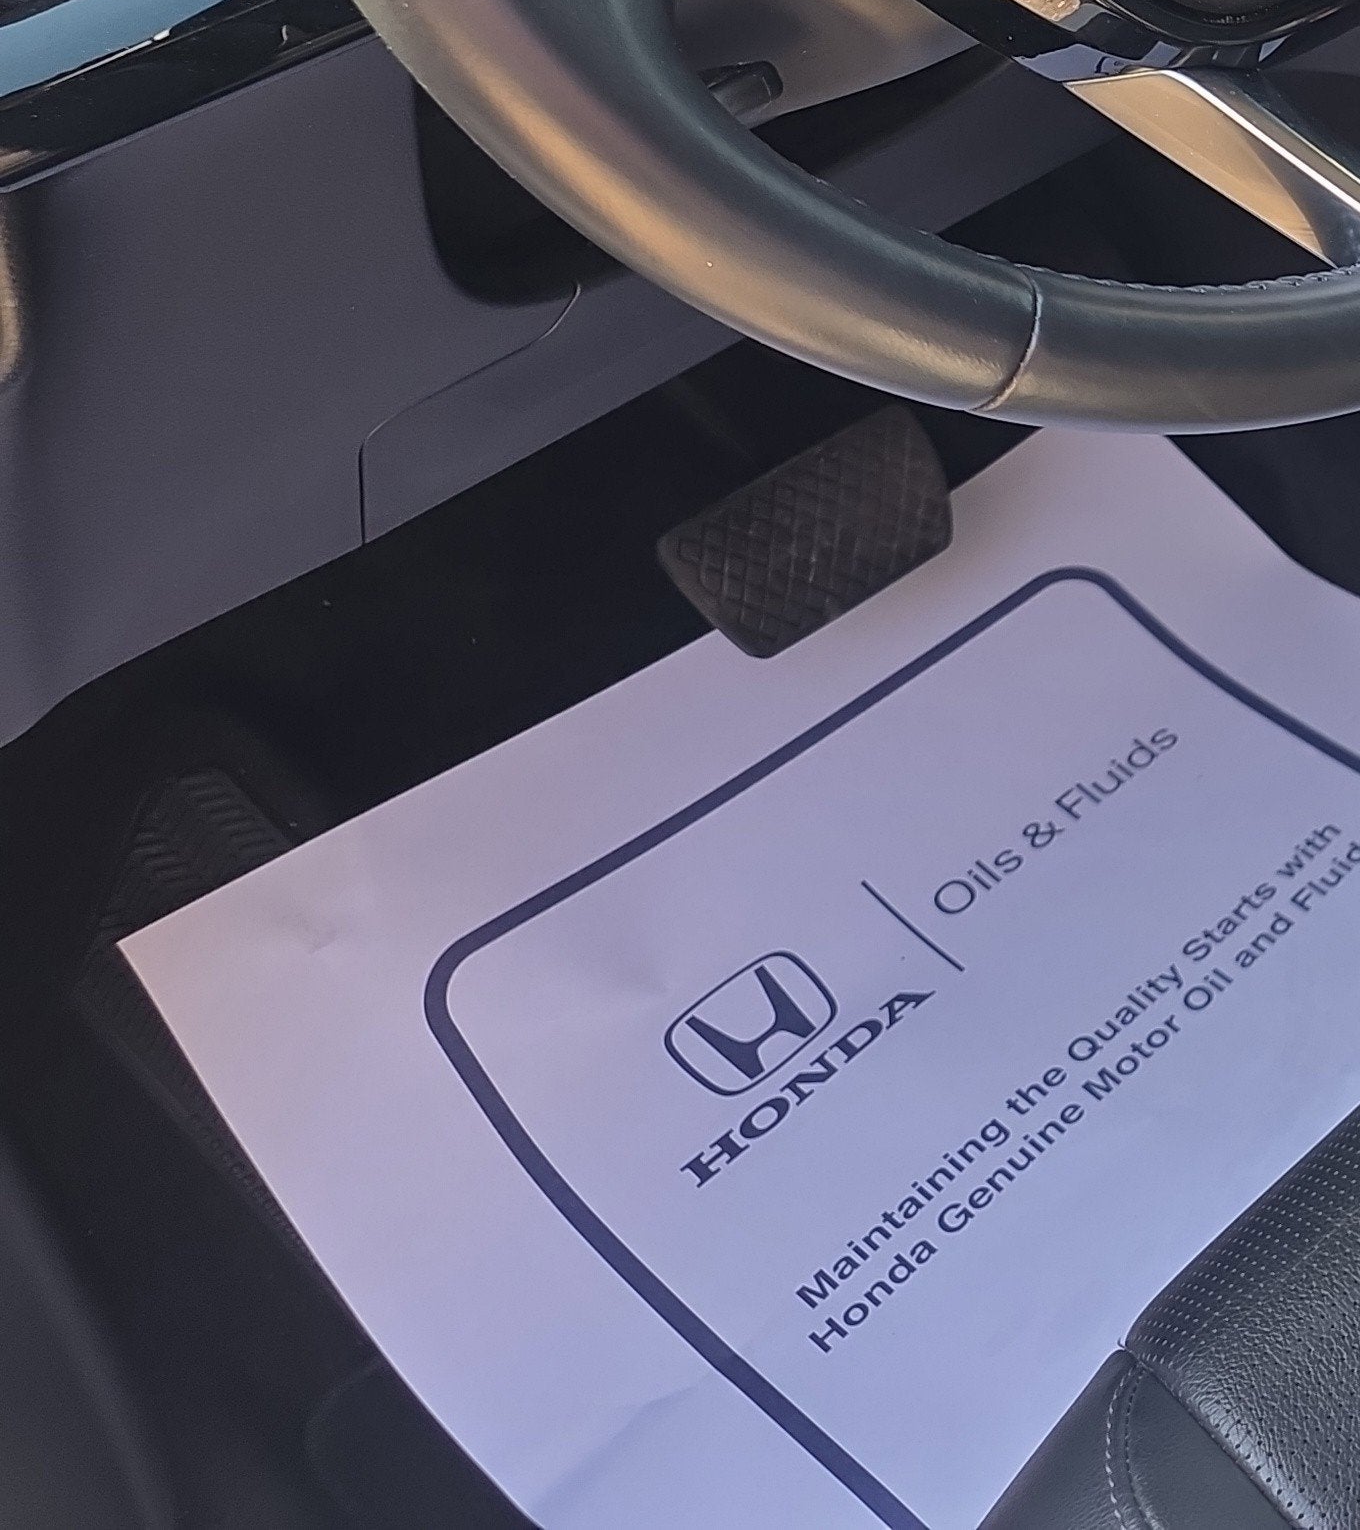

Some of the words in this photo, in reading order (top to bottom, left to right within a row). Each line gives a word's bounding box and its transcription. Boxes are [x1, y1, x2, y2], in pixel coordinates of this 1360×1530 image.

[933, 845, 1025, 916] Oils
[1021, 820, 1066, 849] &
[1054, 726, 1180, 822] Fluids
[680, 989, 937, 1188] HONDA
[794, 1114, 1013, 1312] Maintaining
[1005, 1063, 1069, 1120] the
[1067, 963, 1186, 1065] Quality
[1181, 879, 1279, 965] Starts
[1276, 820, 1342, 881] with
[807, 1236, 940, 1354] Honda
[936, 1100, 1087, 1236] Genuine
[1081, 1012, 1184, 1102] Motor
[1182, 965, 1237, 1014] Oil
[1233, 917, 1296, 971] and
